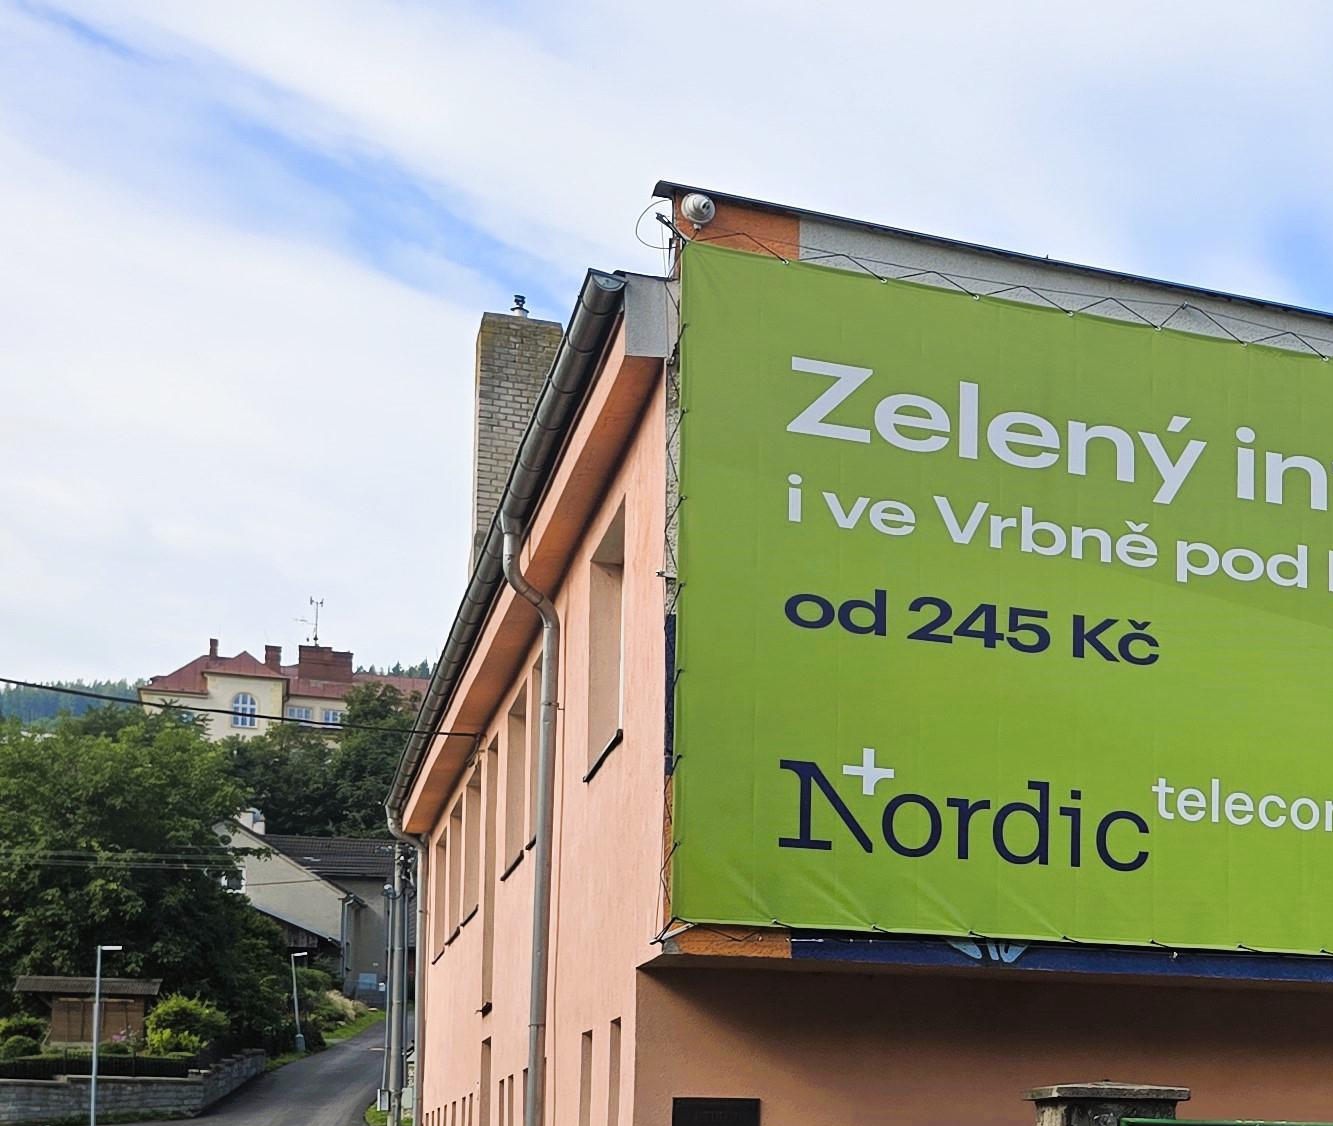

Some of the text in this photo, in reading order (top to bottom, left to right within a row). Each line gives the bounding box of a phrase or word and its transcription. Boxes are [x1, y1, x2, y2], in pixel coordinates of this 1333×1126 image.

[786, 356, 1207, 505] Zelený
[787, 473, 803, 523] i
[822, 491, 916, 536] ve
[933, 495, 1158, 568] Vrbně
[1176, 540, 1308, 589] pod
[784, 588, 1160, 666] od 245 Kč
[778, 755, 1150, 872] Nordic
